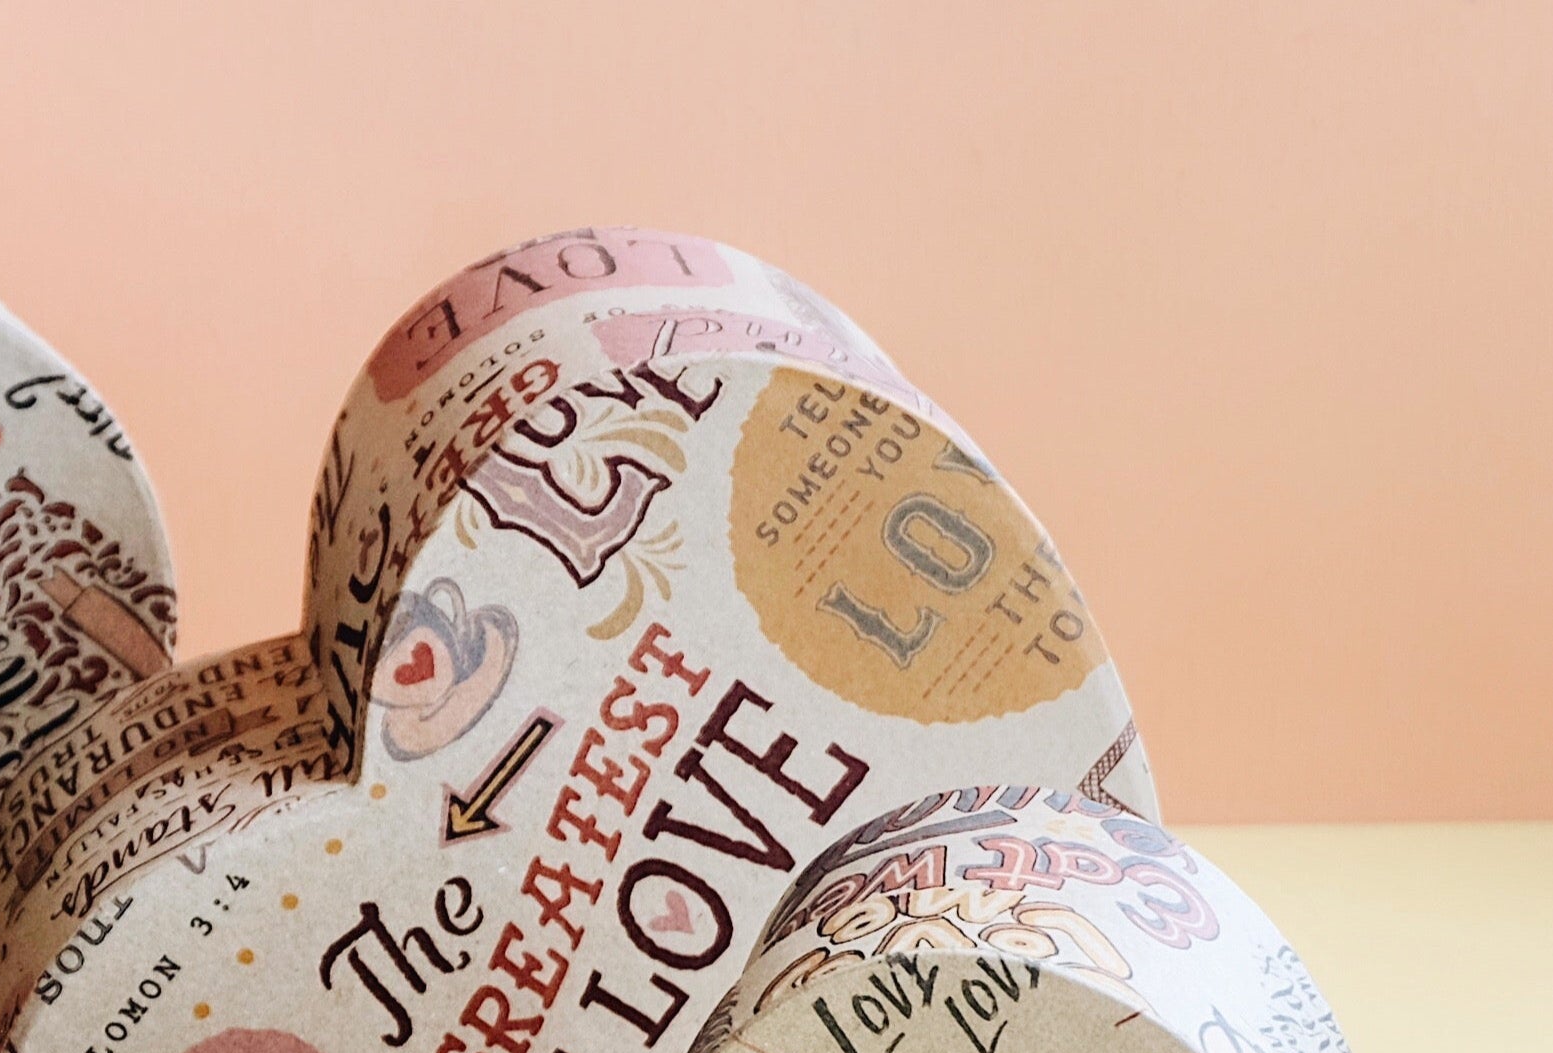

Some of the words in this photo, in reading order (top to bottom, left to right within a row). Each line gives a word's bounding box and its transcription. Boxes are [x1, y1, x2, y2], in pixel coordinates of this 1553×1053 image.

[406, 240, 694, 373] LOVE
[755, 390, 892, 548] SOMEONE
[854, 414, 922, 482] YOU
[579, 678, 871, 1049] LOVE
[319, 876, 485, 1048] The
